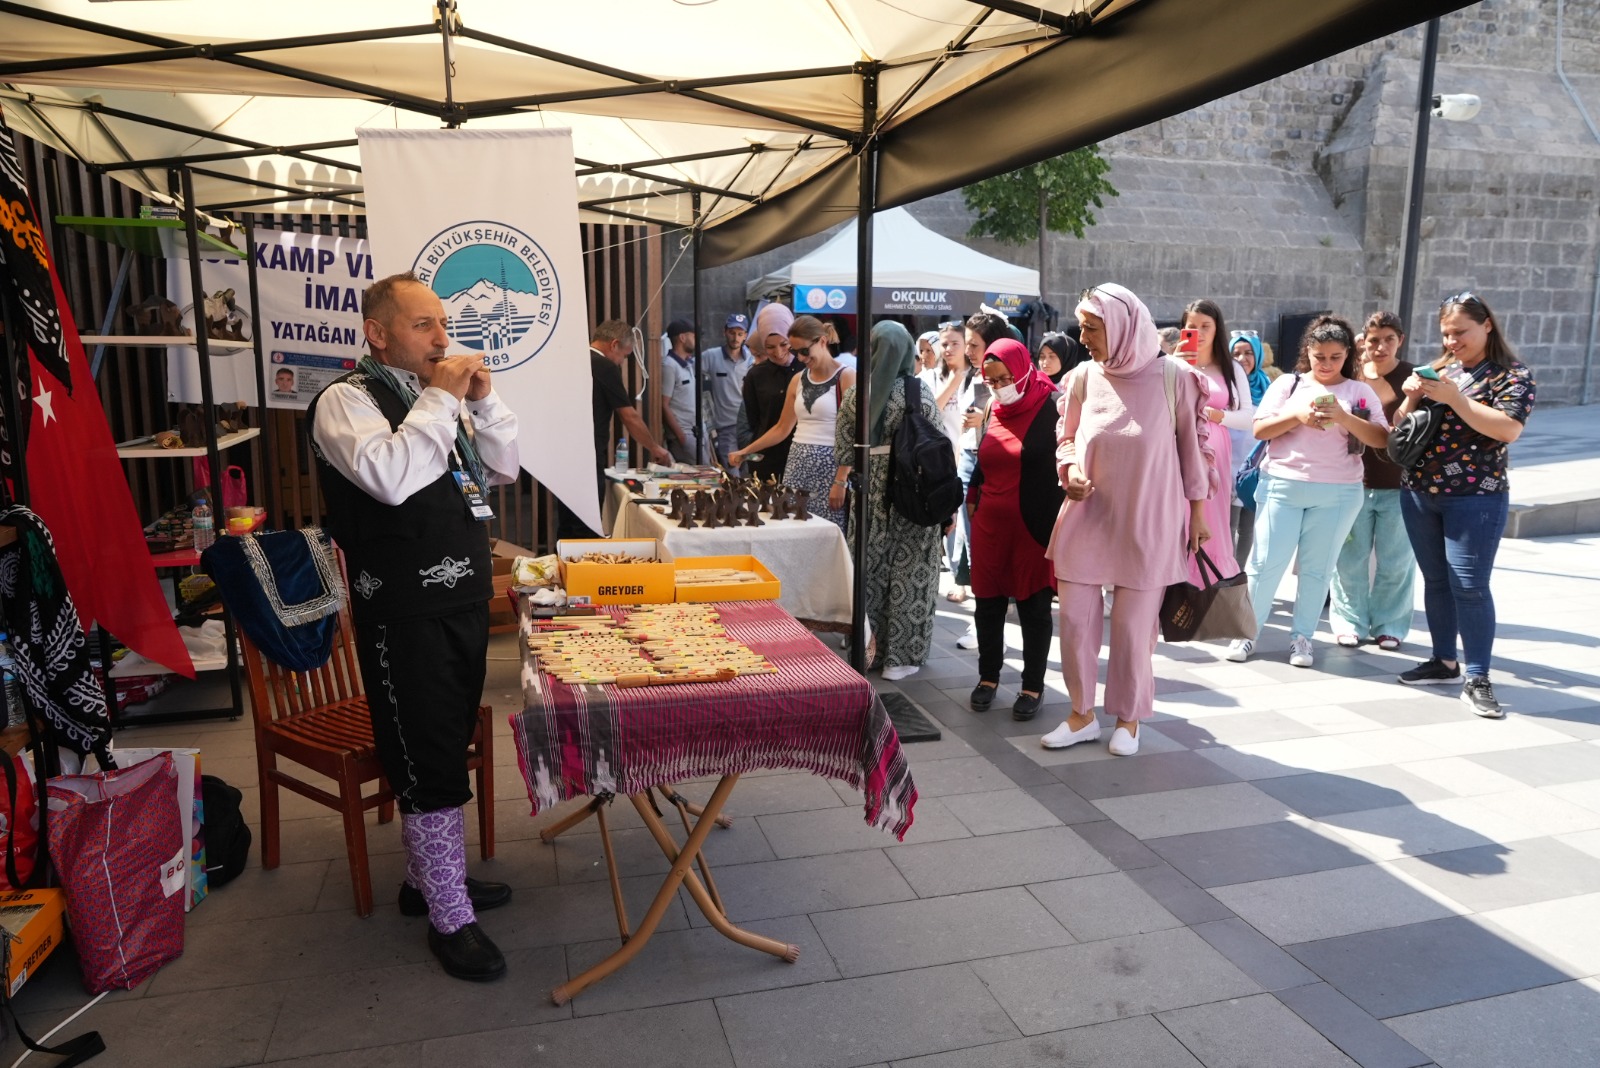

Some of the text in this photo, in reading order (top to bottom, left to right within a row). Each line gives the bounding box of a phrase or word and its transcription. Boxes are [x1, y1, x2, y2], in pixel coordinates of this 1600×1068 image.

[254, 242, 335, 274] KAMP
[426, 229, 518, 266] BÜYÜKŞEHİR
[519, 245, 554, 326] BELEDİYESİ
[305, 277, 364, 314] İMA
[891, 290, 947, 304] OKÇULUK
[271, 321, 356, 346] YATAĞAN
[483, 353, 510, 366] 869
[598, 585, 644, 596] GREYDER
[167, 858, 185, 879] BO
[23, 935, 52, 971] GREYDER
